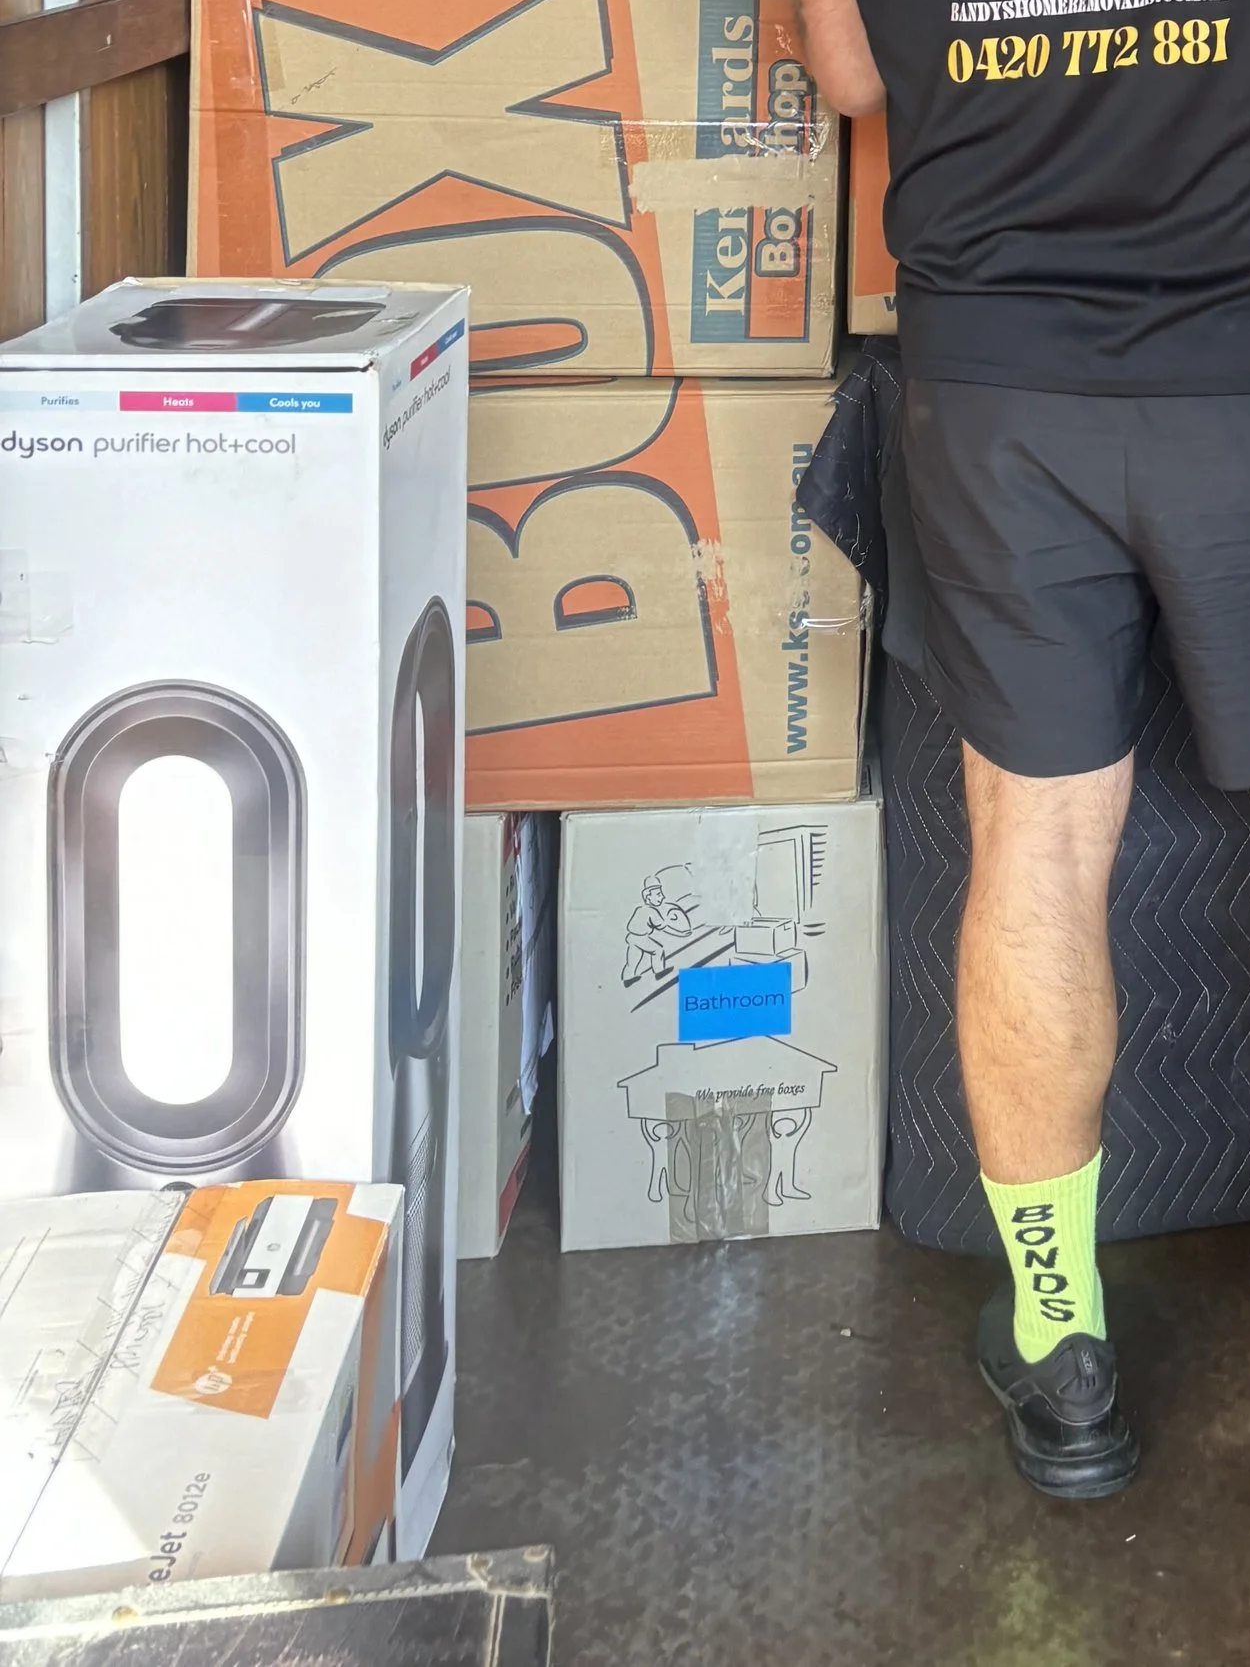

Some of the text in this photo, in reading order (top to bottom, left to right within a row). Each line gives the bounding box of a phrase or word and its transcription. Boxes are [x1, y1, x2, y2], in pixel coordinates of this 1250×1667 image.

[947, 16, 1232, 85] 0420 772 881
[40, 395, 321, 410] Purifies Heats Cools you
[0, 430, 297, 459] dyson purifier hot+cool
[683, 989, 786, 1013] Bathroom
[777, 1081, 806, 1096] boxes
[1011, 1202, 1078, 1324] BONDS
[172, 1471, 212, 1526] 8012e
